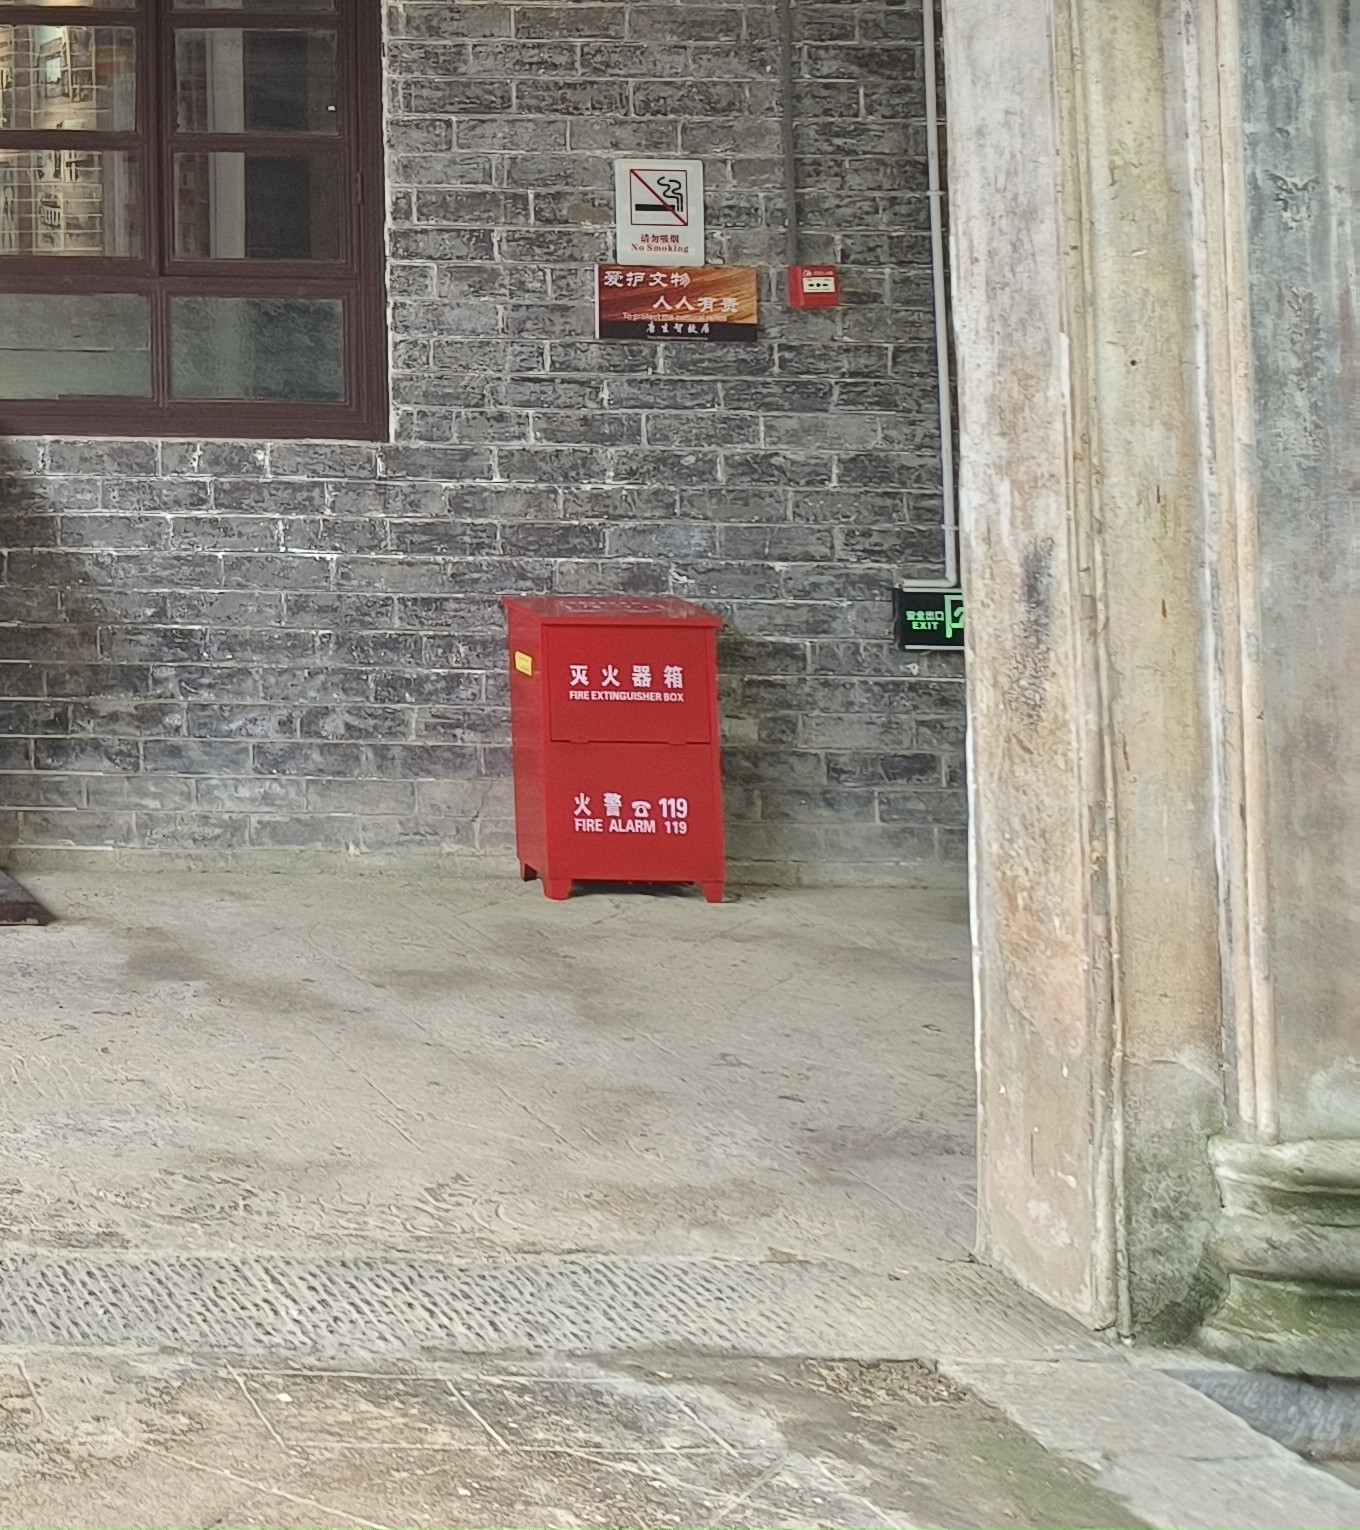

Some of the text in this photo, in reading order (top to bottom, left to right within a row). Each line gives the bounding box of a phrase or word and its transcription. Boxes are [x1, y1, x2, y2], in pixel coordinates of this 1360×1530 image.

[631, 243, 689, 254] No Smoking
[603, 270, 691, 288] 爱护文物
[652, 295, 739, 313] 人人有责
[911, 621, 940, 631] EXIT
[569, 664, 684, 689] 灭火器箱
[569, 690, 684, 702] FIRE EXTINGUISHER BOX
[573, 792, 688, 819] 火警 119
[574, 818, 687, 835] FIRE ALARM 119
